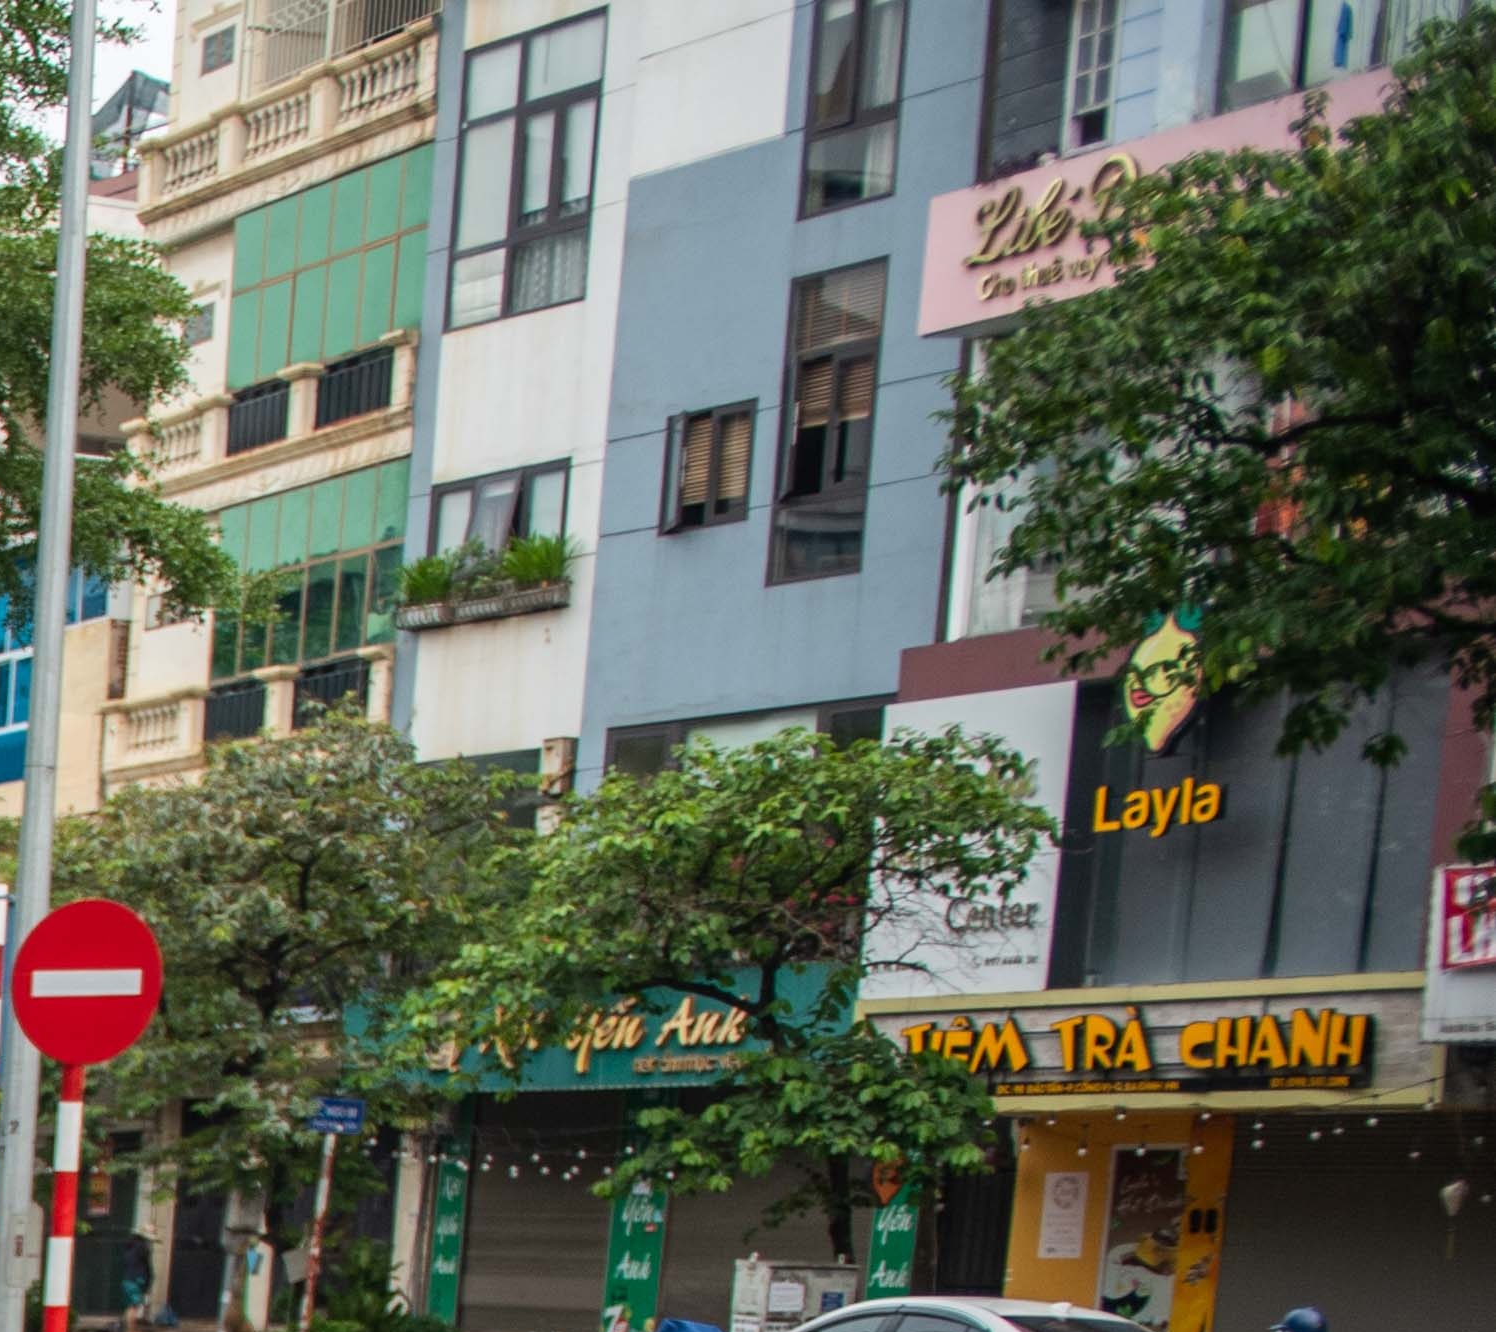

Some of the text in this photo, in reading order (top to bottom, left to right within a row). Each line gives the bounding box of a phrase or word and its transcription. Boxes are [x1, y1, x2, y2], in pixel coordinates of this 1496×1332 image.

[978, 273, 1016, 301] Cho
[1020, 257, 1062, 290] thuê
[1092, 777, 1222, 839] Layla
[945, 896, 1040, 933] Center
[1051, 1005, 1152, 1074] TRÀ
[1179, 1008, 1369, 1070] CHANH
